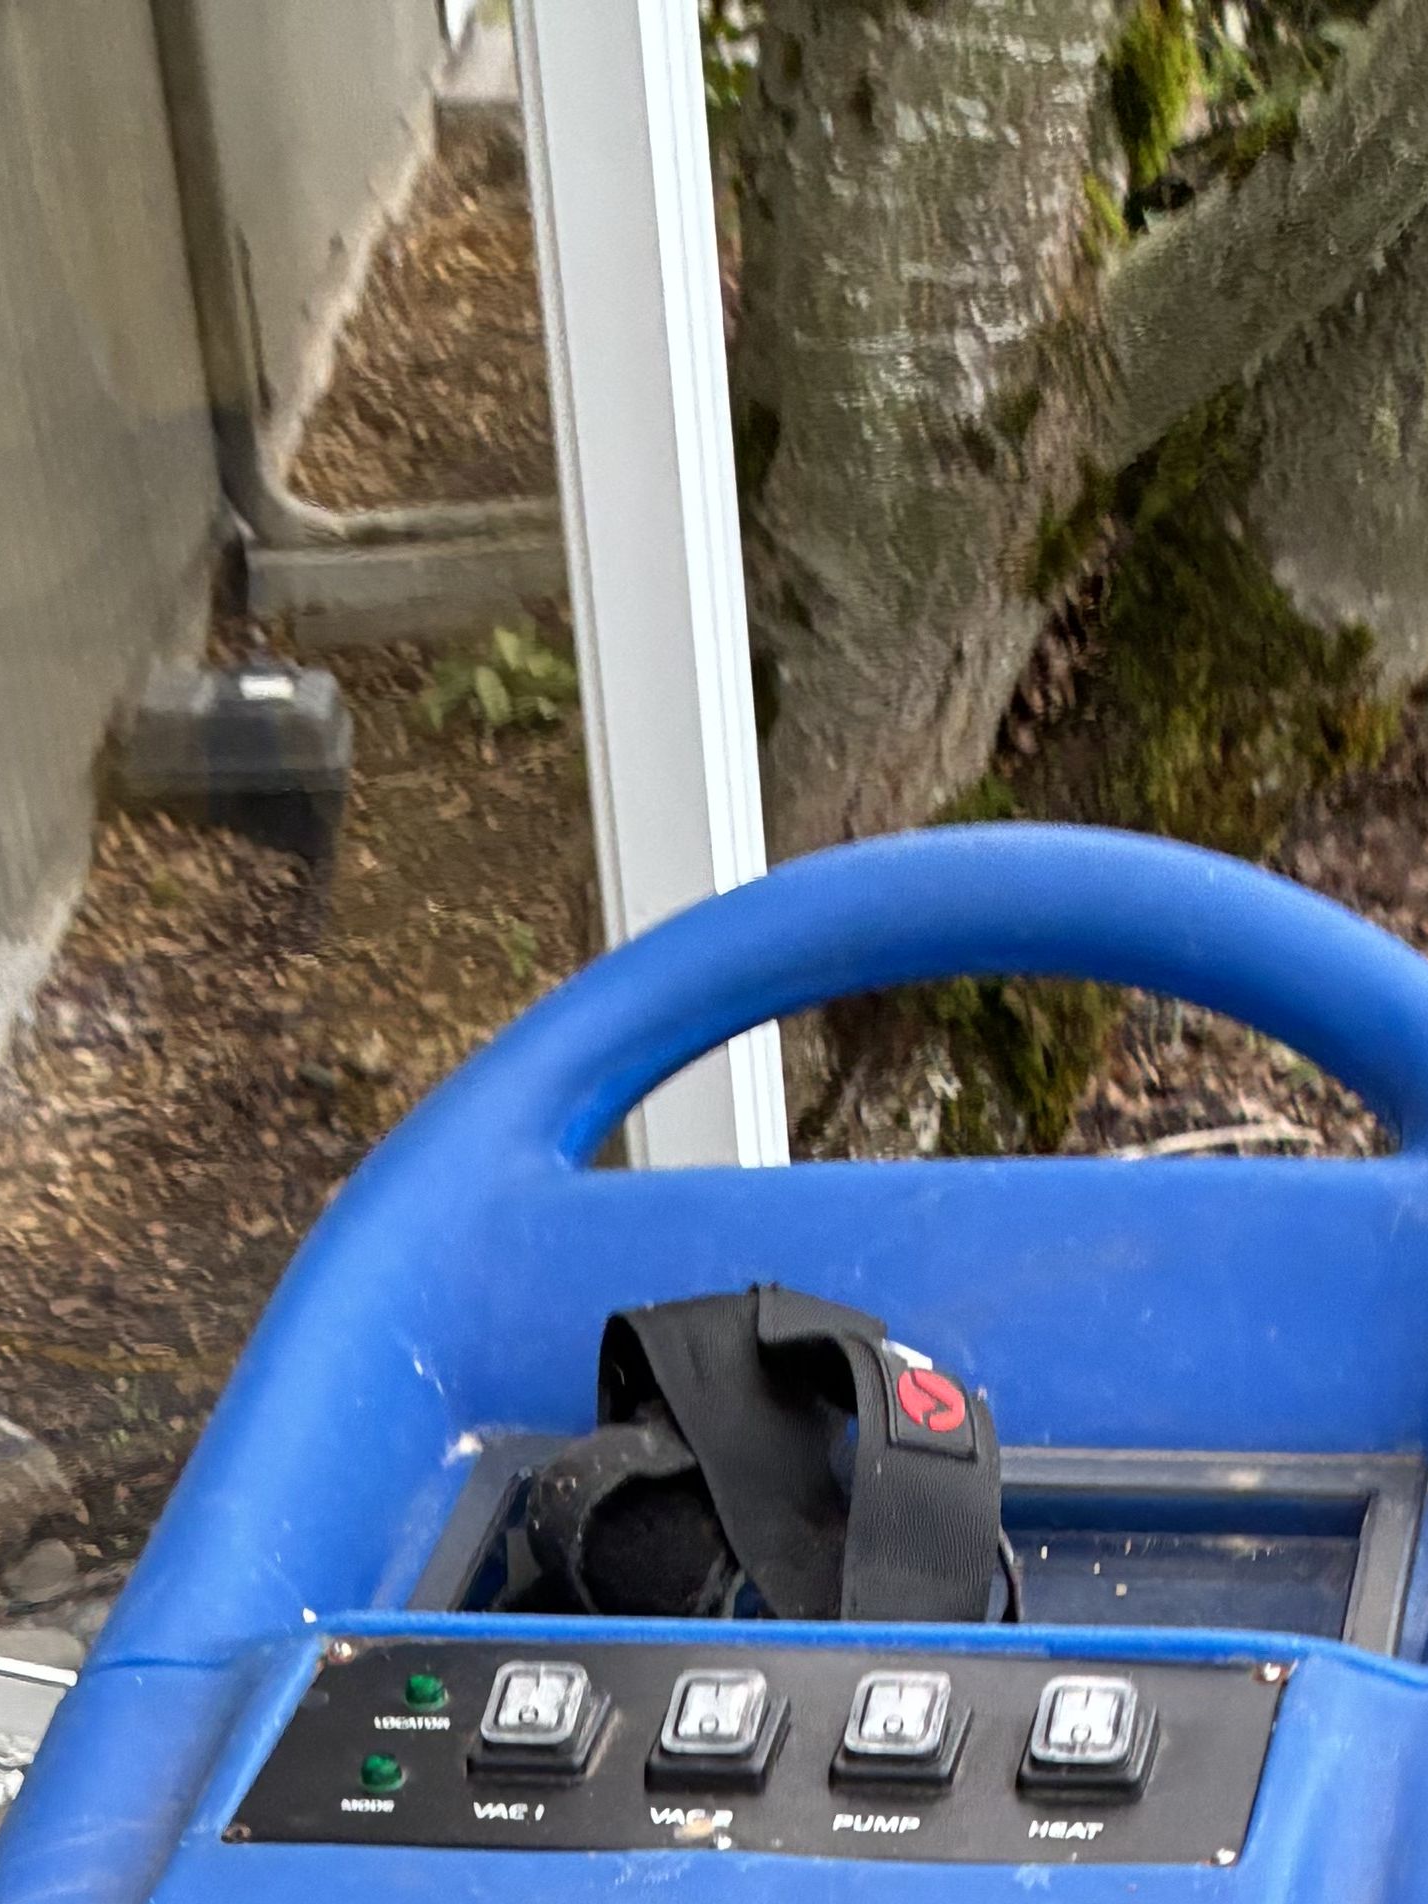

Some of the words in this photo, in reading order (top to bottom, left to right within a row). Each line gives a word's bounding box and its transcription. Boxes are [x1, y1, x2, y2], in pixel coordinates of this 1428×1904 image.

[473, 1801, 529, 1820] VAC
[650, 1807, 706, 1825] VAC
[832, 1813, 920, 1833] PUMP
[1028, 1820, 1104, 1840] HEAT
